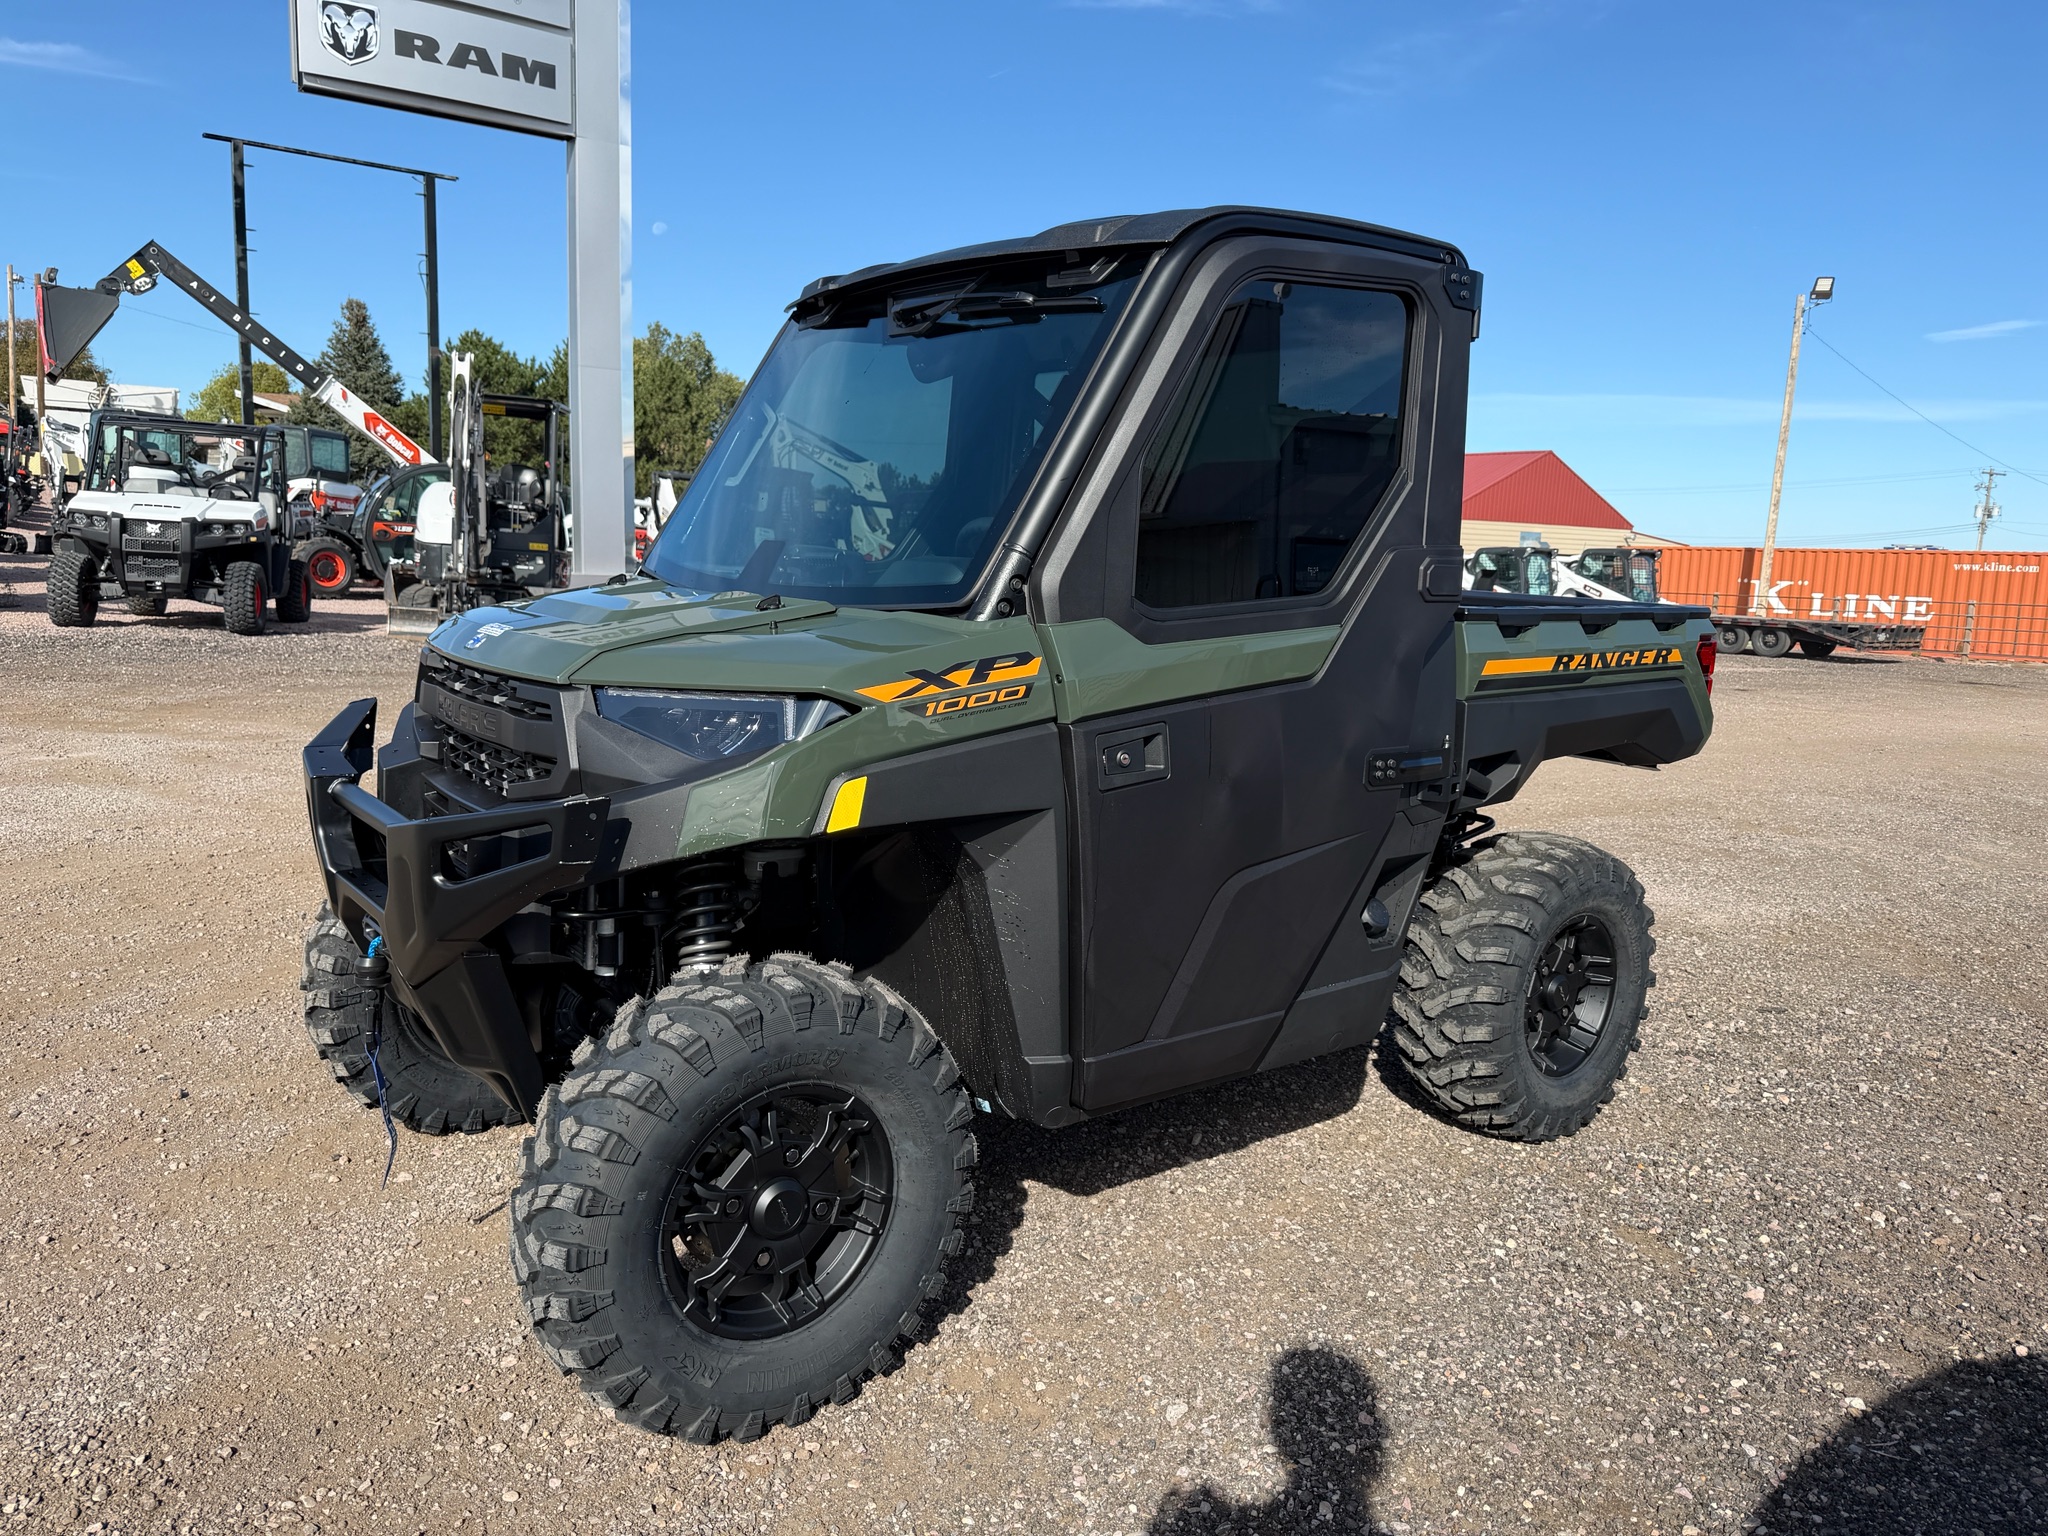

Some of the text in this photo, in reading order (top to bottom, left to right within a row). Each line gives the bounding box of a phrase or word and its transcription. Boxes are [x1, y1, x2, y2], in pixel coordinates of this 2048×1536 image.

[394, 28, 556, 90] RAM
[385, 434, 415, 460] Bobcat
[1952, 561, 2040, 573] www.kline.com
[1809, 591, 1935, 622] LINE
[890, 651, 1036, 700] XP
[1550, 648, 1673, 673] RANGER
[437, 692, 497, 738] POLARIS
[925, 685, 1027, 717] 1000
[929, 701, 1028, 725] DUAL OVERHEAD CAM
[692, 1050, 823, 1125] PRO ARMOR
